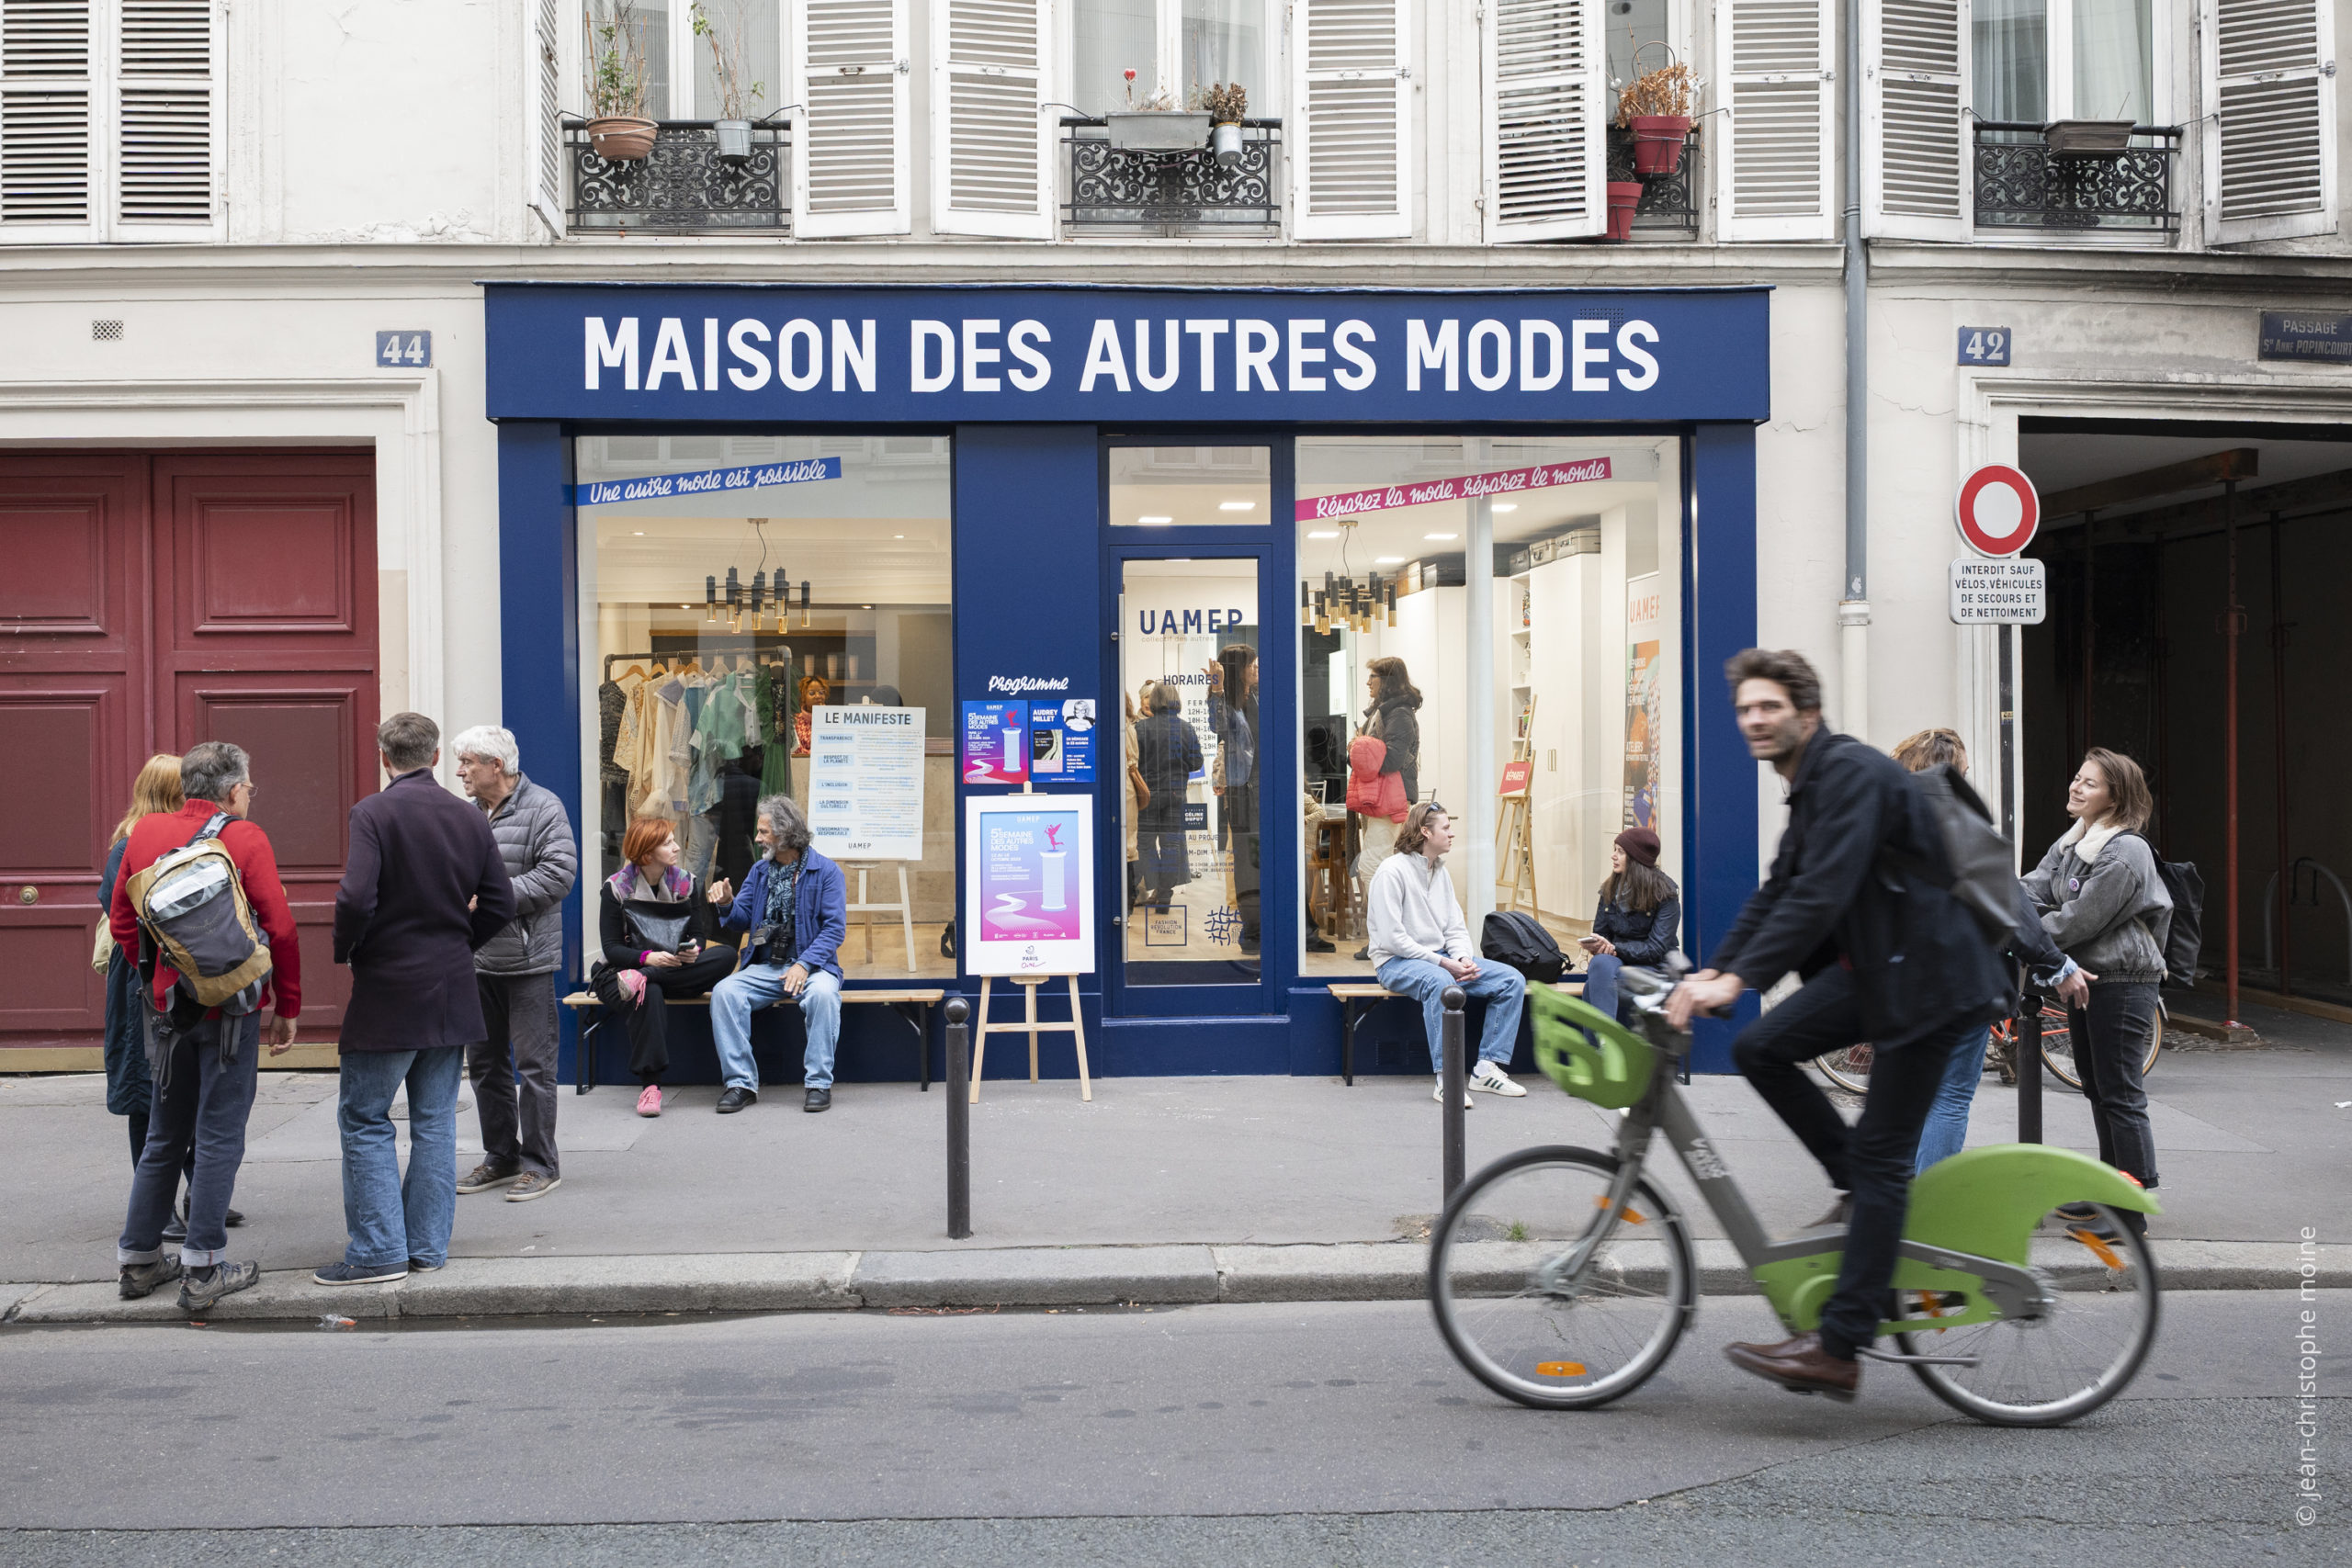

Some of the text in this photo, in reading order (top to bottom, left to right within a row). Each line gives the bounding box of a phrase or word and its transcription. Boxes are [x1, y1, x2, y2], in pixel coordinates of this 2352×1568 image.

[2283, 320, 2337, 334] PASSAGE
[382, 334, 424, 364] 44
[1965, 331, 2004, 361] 42
[2296, 340, 2352, 356] POPINCOURT
[585, 317, 1659, 392] MAISON DES AUTRES MODES
[590, 459, 827, 503] Une autre mode est possible
[1316, 460, 1605, 520] Réparez la mode, réparez le monde
[1962, 565, 2035, 575] INTERDIT SAUF
[1961, 593, 2036, 604] DE SECOURS ET
[1961, 608, 2037, 617] DE NETTOIMENT
[1139, 608, 1243, 635] UAMEP
[1163, 674, 1219, 685] HORAIRES
[825, 712, 911, 725] LE MANIFESTE
[999, 830, 1033, 839] SEMAINE
